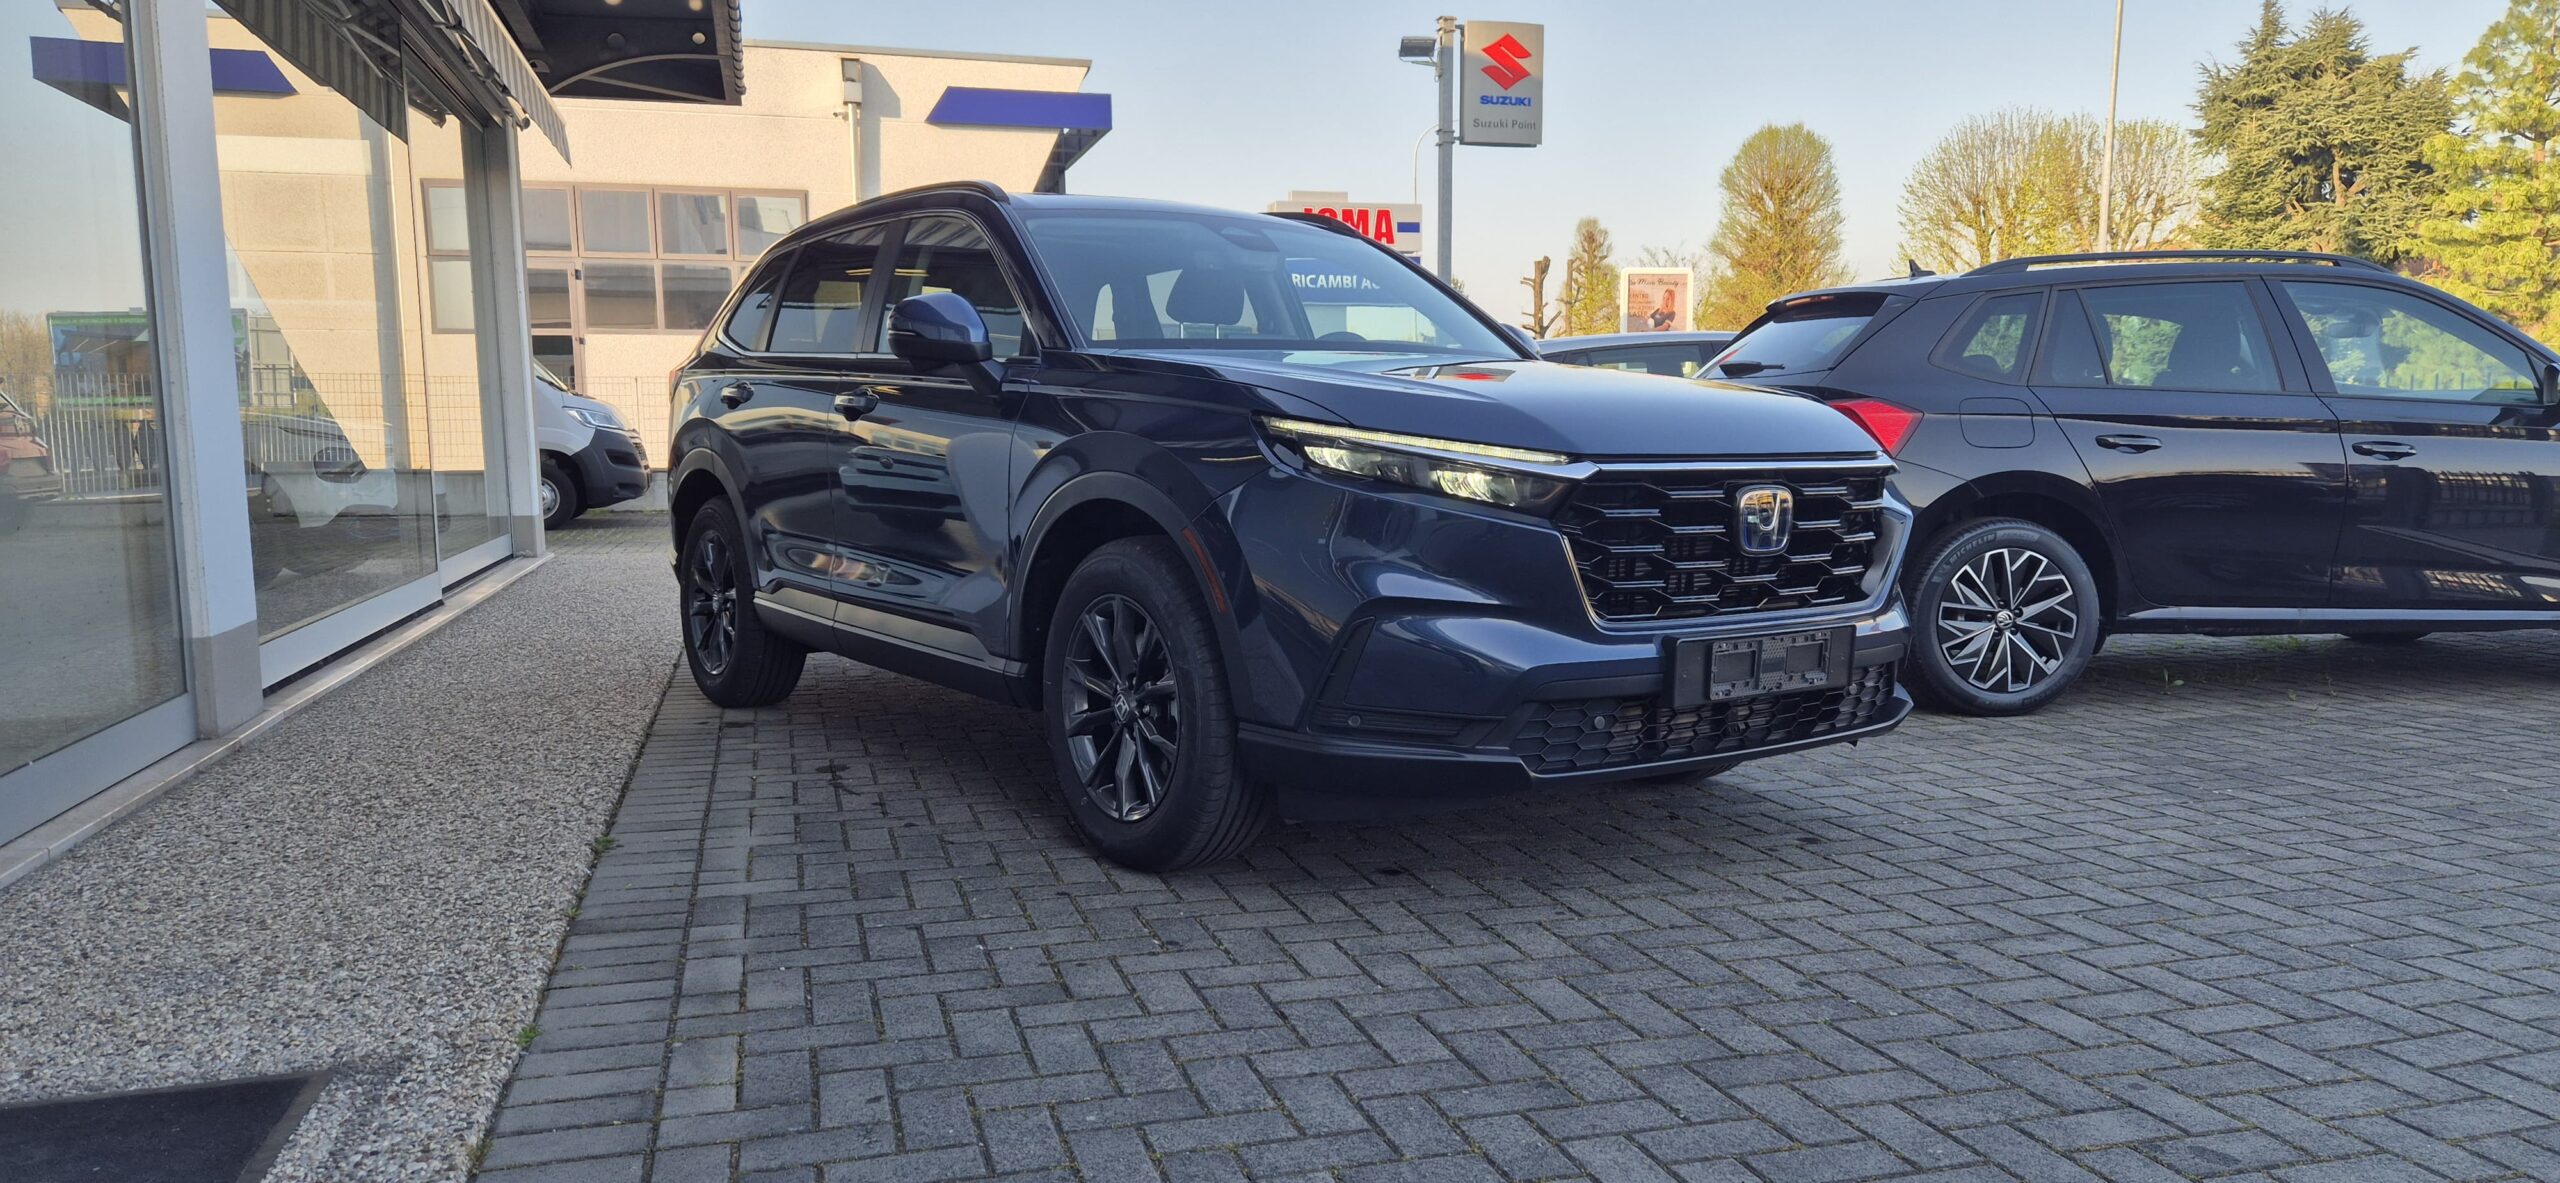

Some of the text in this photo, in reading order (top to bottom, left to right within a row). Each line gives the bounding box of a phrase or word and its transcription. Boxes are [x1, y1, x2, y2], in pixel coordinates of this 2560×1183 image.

[1479, 95, 1532, 107] SUZUKI
[1473, 118, 1537, 130] Suzuki Point
[1303, 207, 1396, 245] MA
[1291, 273, 1358, 289] RICAMBI
[1949, 533, 1996, 564] MICHELIN
